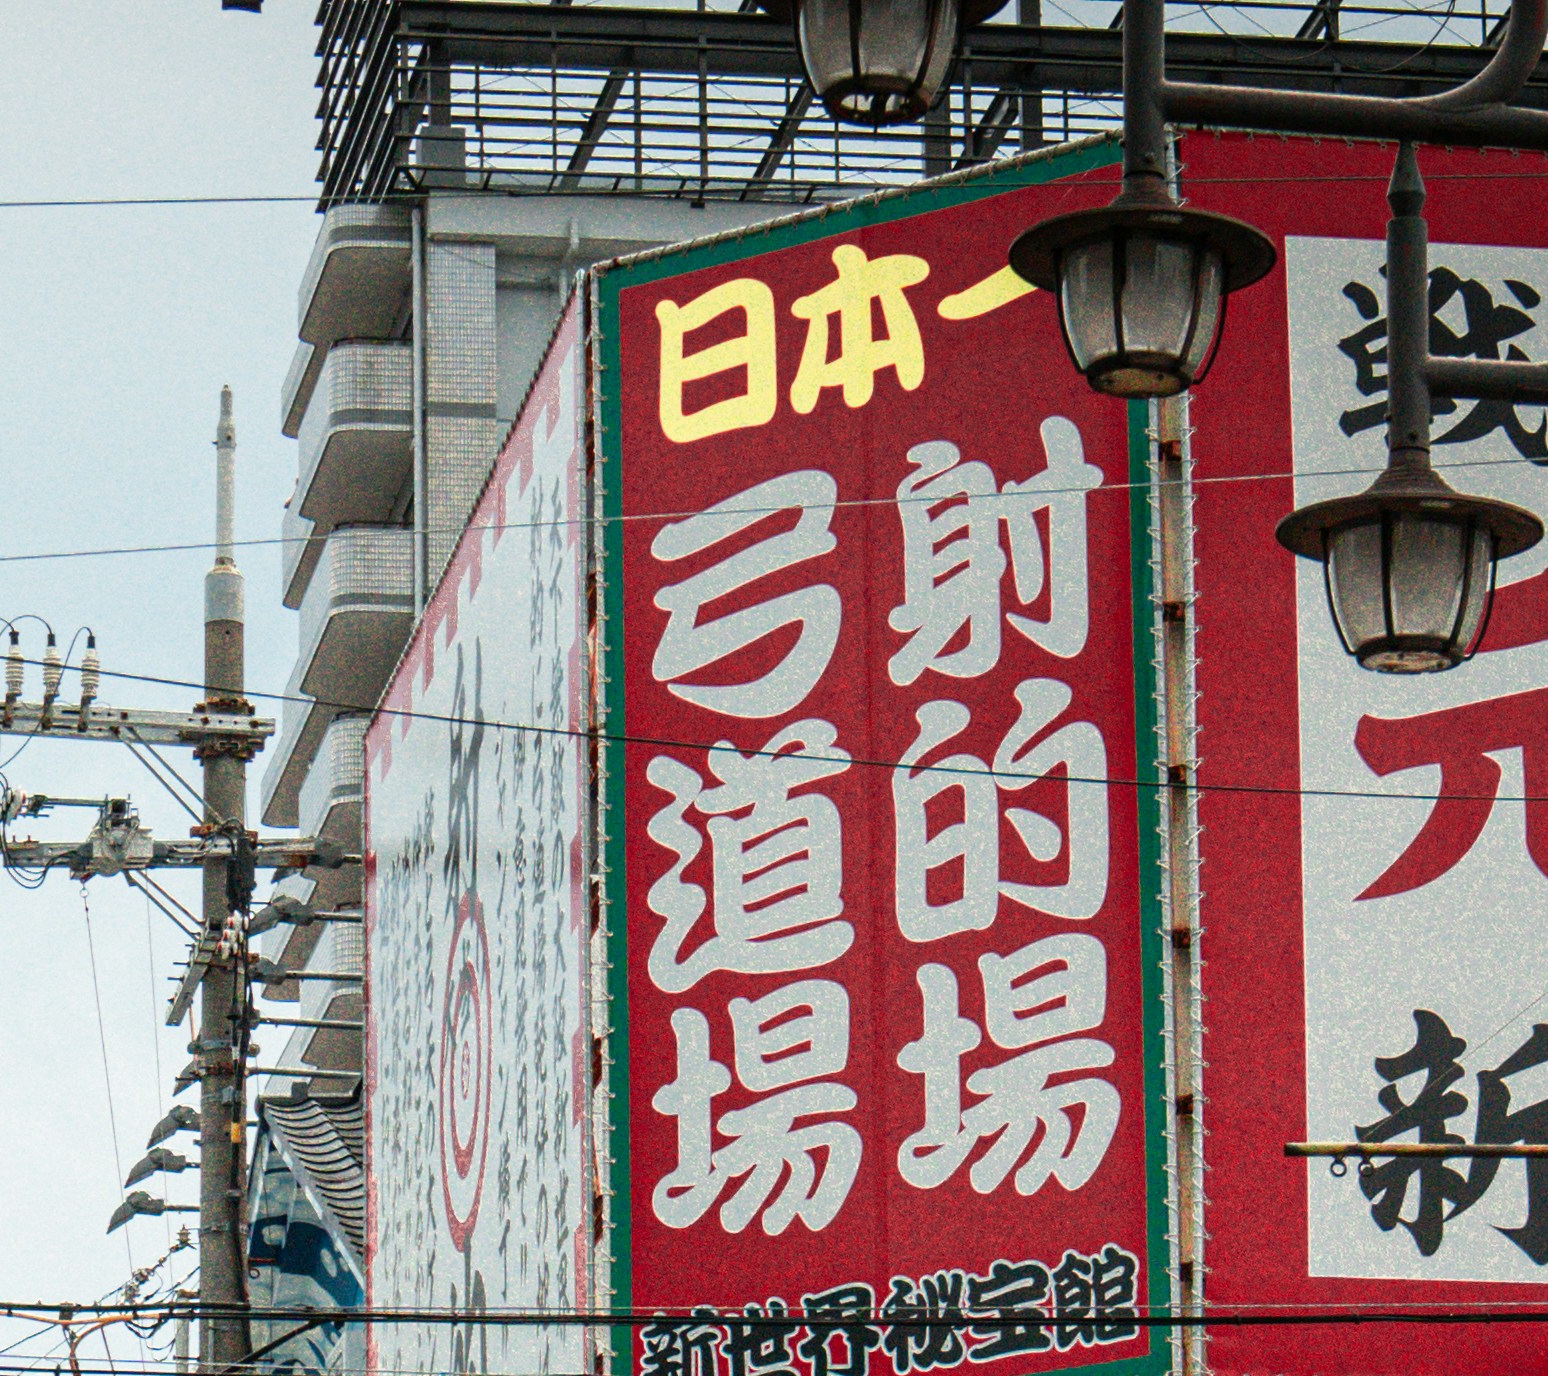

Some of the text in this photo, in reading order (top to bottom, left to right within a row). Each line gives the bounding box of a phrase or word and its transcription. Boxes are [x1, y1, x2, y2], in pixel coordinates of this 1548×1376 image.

[656, 243, 1042, 445] 日本一
[649, 470, 861, 1237] 弓道場
[887, 415, 1122, 1197] 射的場
